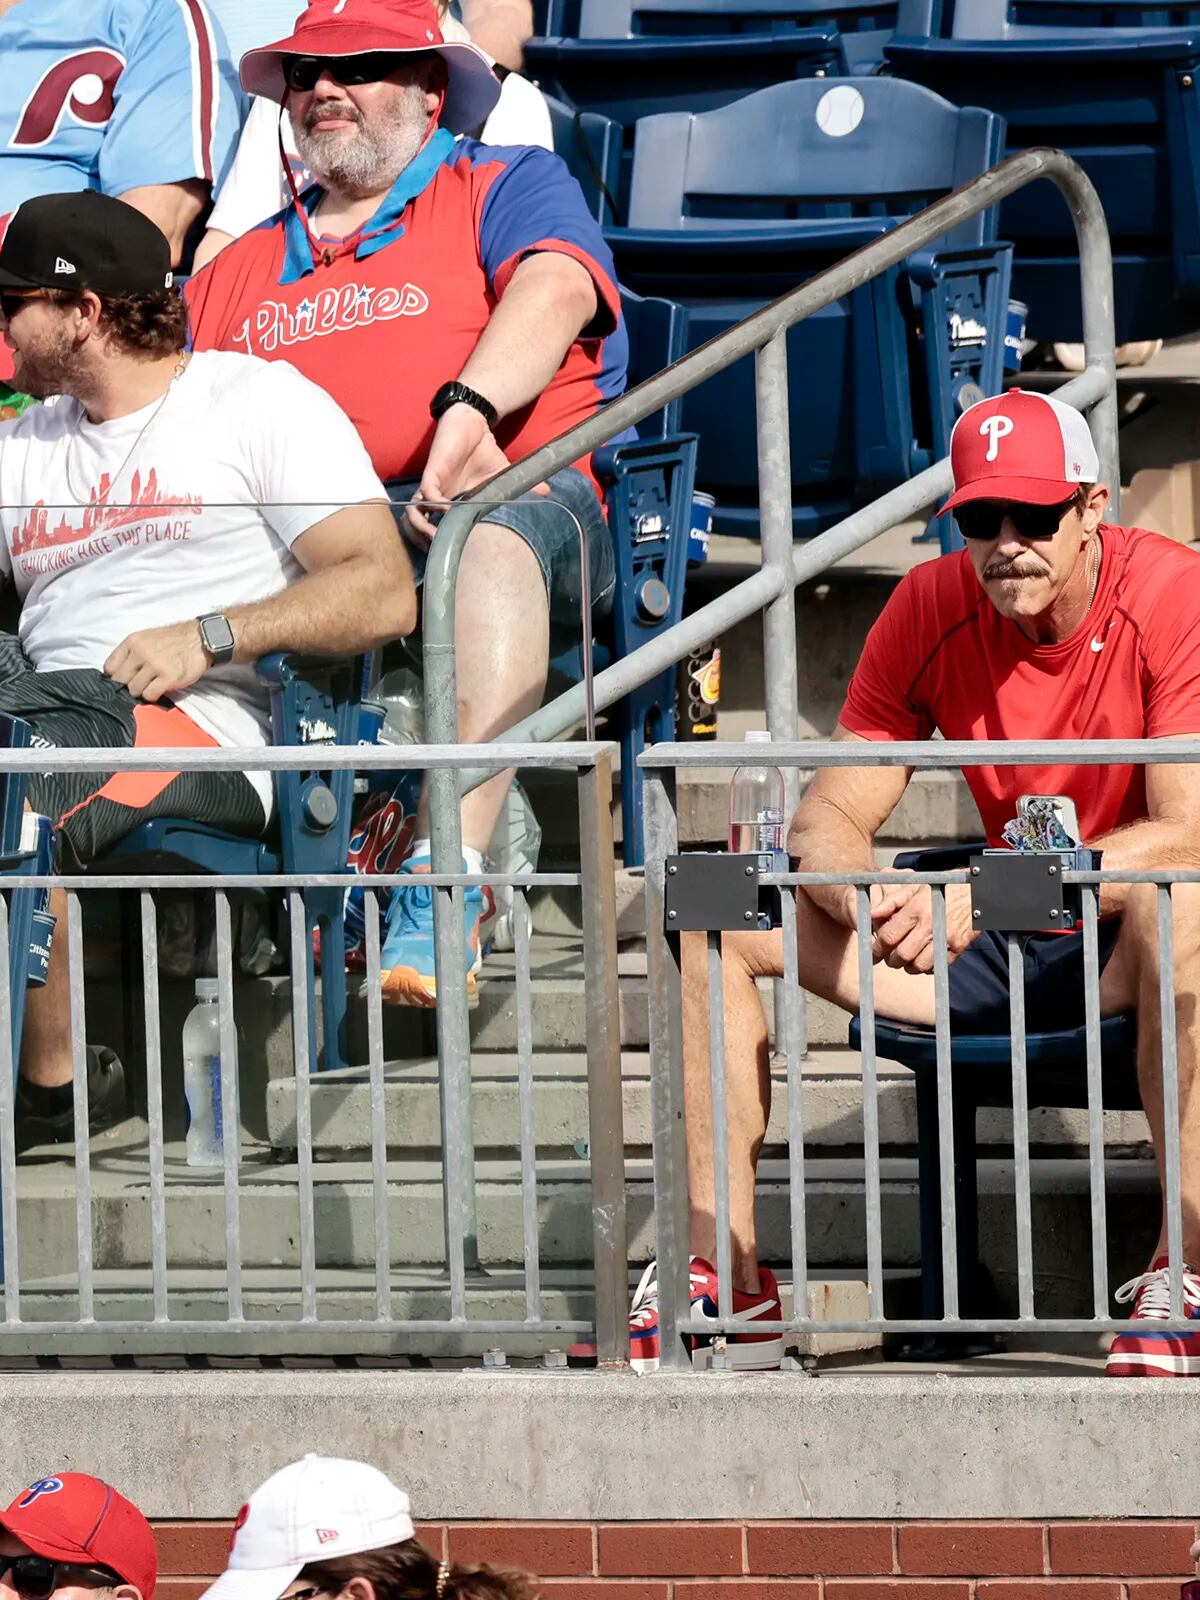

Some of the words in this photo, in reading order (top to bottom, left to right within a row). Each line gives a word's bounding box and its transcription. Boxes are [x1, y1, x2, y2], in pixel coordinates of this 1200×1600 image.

[232, 283, 430, 356] Phillies
[979, 415, 1014, 462] P
[78, 535, 112, 560] HATE
[113, 526, 142, 547] THIS
[145, 520, 193, 543] PLACE
[20, 1477, 64, 1508] P
